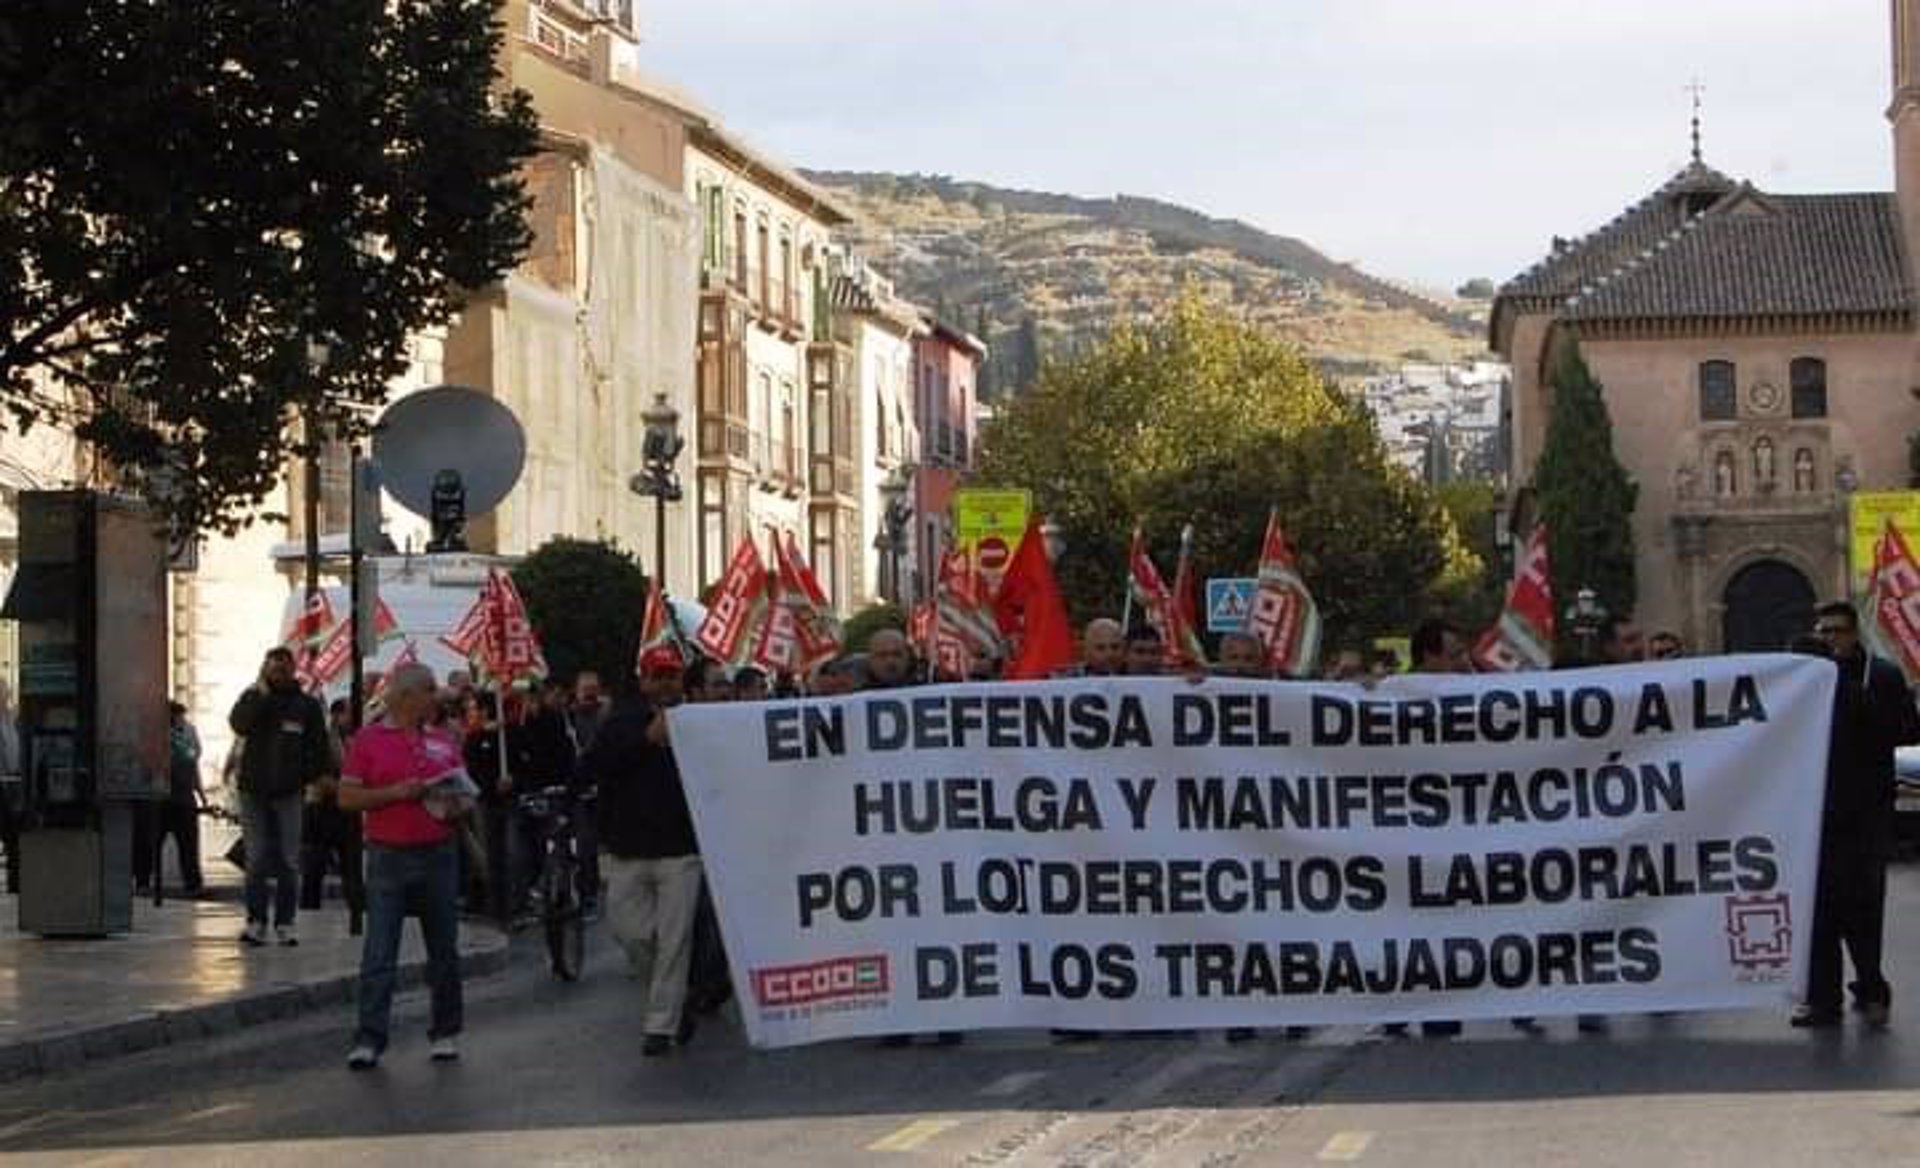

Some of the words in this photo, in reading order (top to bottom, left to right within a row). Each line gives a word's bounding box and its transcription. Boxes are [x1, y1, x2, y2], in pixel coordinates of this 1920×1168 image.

[765, 705, 846, 761] EN
[866, 694, 1153, 751] DEFENSA
[1173, 694, 1291, 747] DEL
[1310, 688, 1614, 747] DERECHO
[1632, 681, 1674, 735] A
[1692, 674, 1768, 730] LA
[853, 776, 1103, 836] HUELGA
[1117, 777, 1157, 830] Y
[1176, 751, 1686, 831] MANIFESTACIÓN
[797, 863, 921, 928] POR
[1038, 855, 1388, 916] DERECHOS
[1408, 836, 1778, 909] LABORALES
[916, 943, 999, 1001] DE
[1017, 942, 1139, 1000] LOS
[1154, 926, 1662, 999] TRABAJADORES
